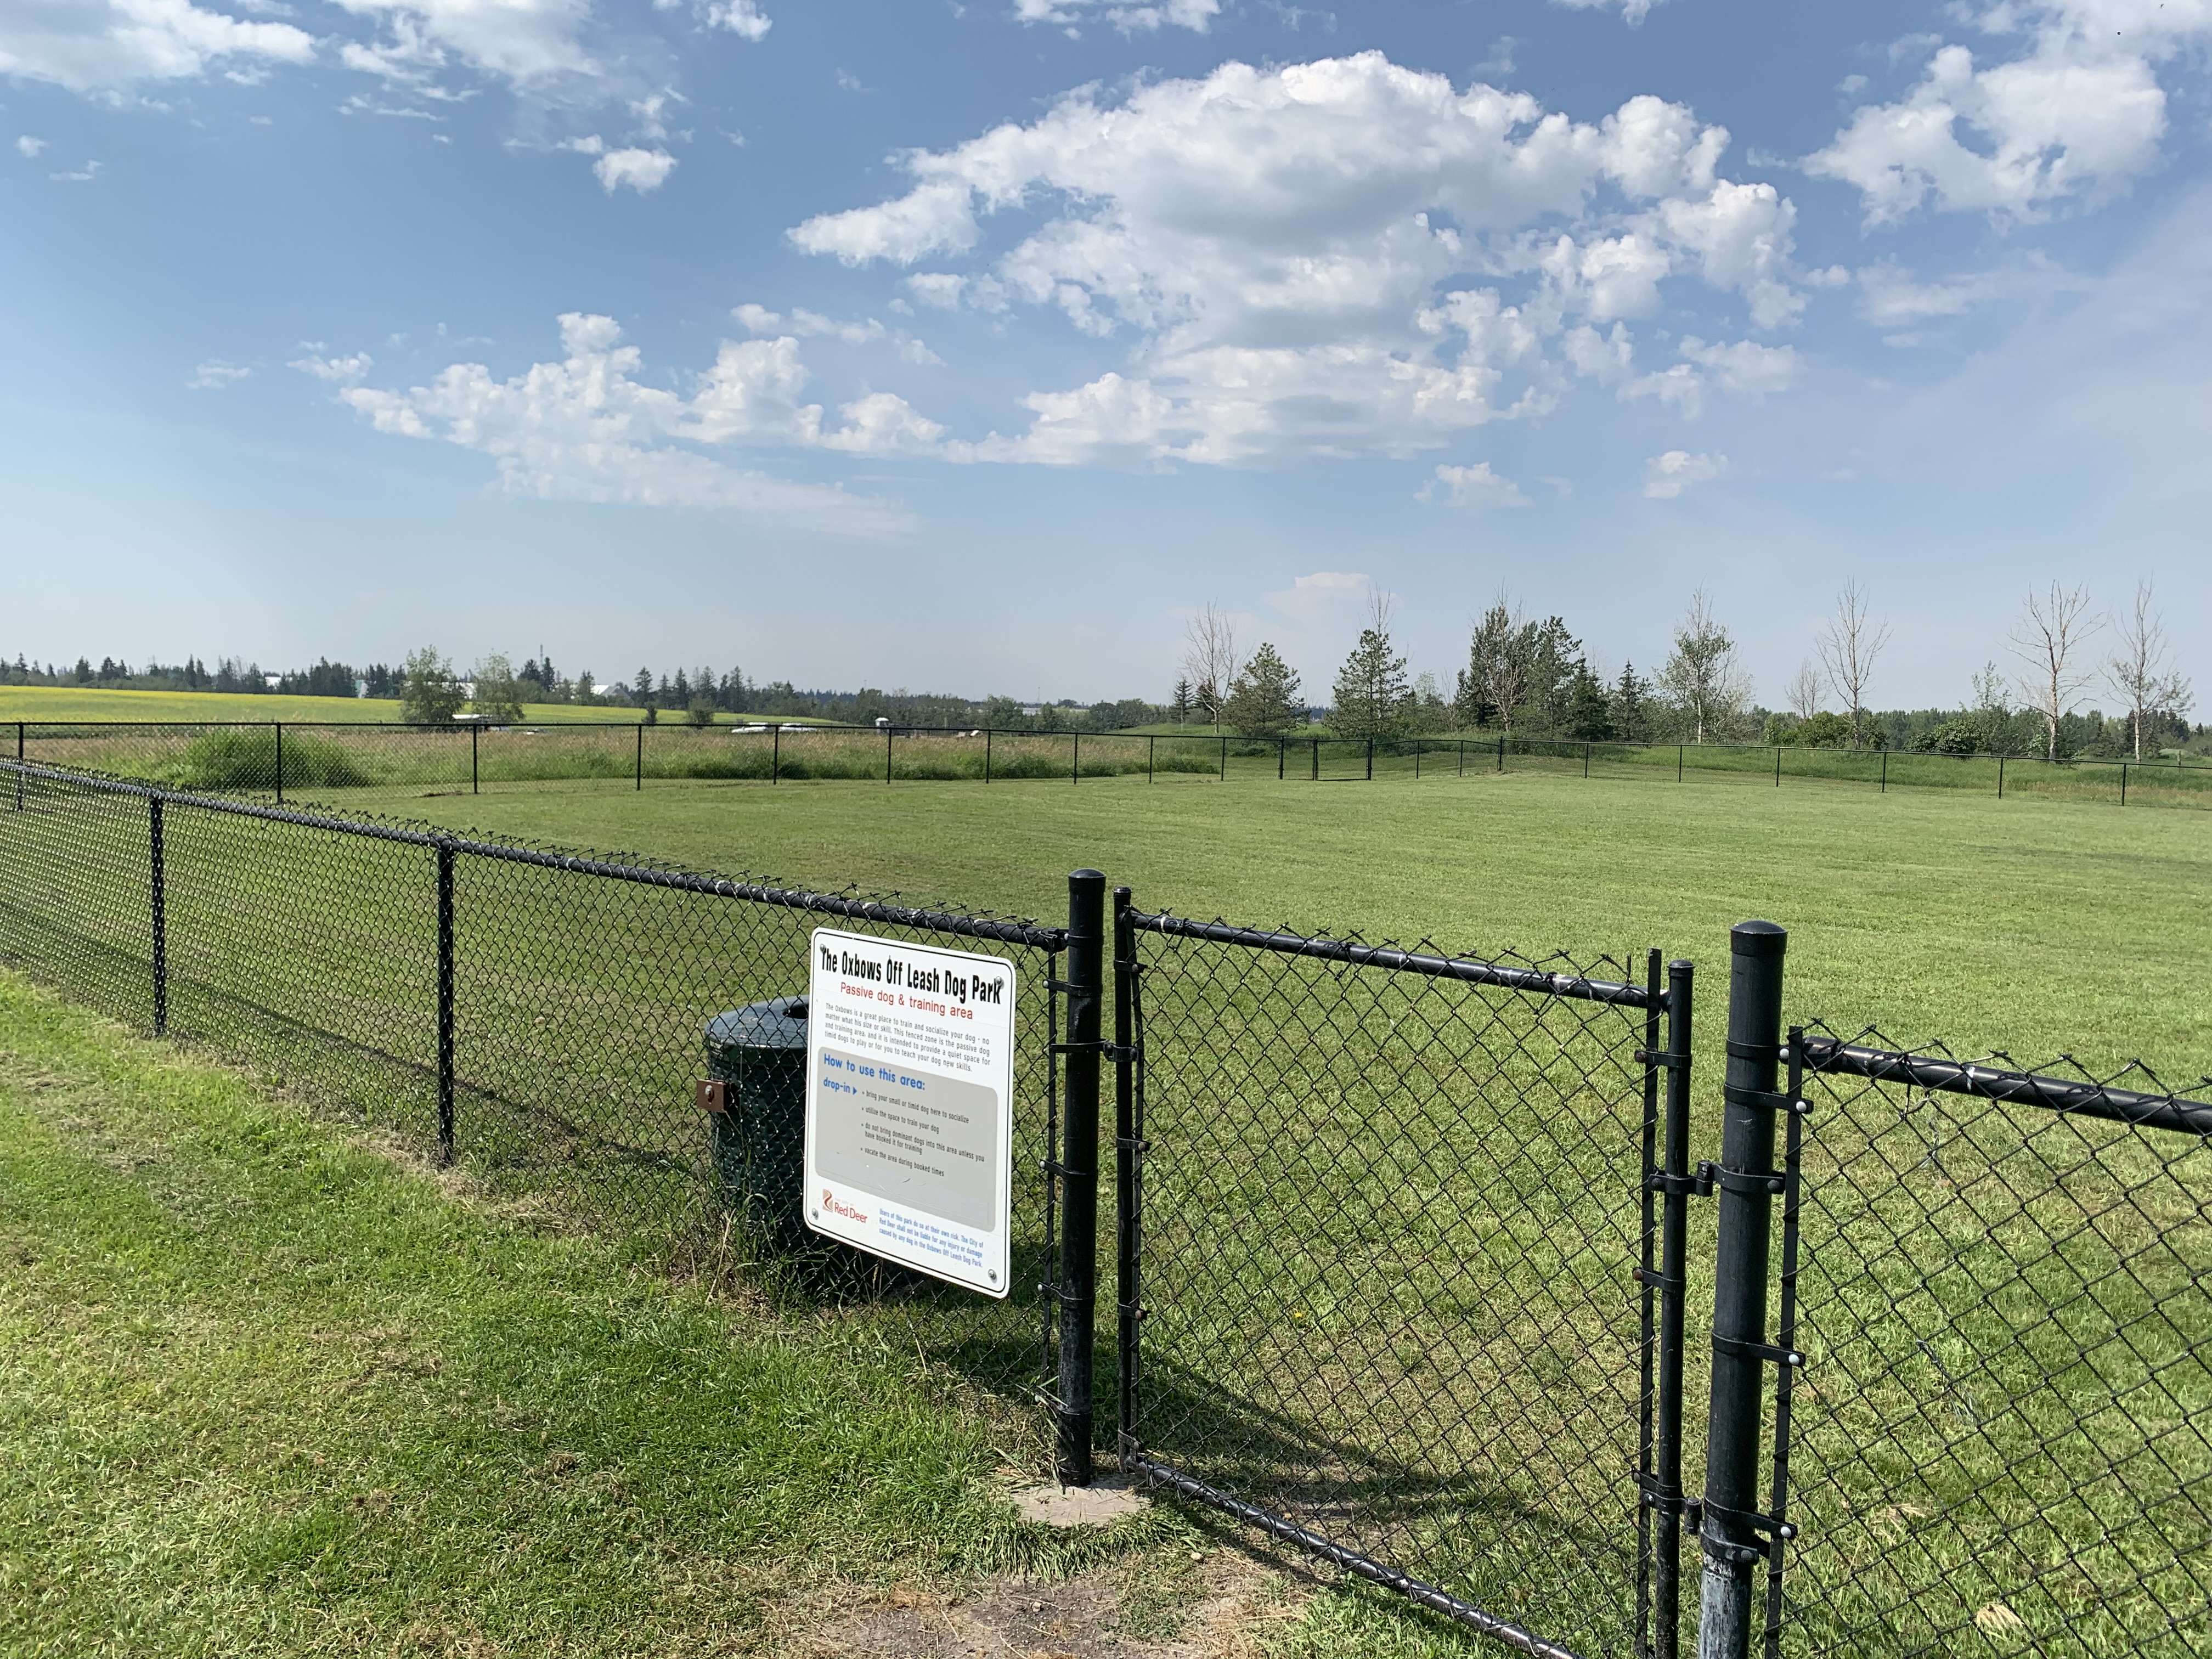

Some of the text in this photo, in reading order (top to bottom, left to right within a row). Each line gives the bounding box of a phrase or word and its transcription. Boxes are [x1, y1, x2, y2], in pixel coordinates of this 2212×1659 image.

[842, 951, 881, 981] Oxbows
[886, 958, 902, 985] Off
[907, 963, 939, 992] Leash
[944, 970, 967, 1003] Dog
[972, 975, 1002, 1005] Park
[841, 982, 973, 1019] Passive dog & training area
[825, 1013, 840, 1021] matter
[842, 1015, 853, 1024] what
[862, 1020, 872, 1029] size
[894, 1027, 904, 1036] This
[905, 1029, 923, 1040] fenced
[924, 1035, 938, 1044] zone
[939, 1037, 944, 1045] is
[945, 1039, 955, 1047] the
[956, 1042, 977, 1052] passive
[979, 1046, 990, 1057] dog
[826, 1002, 834, 1011] The
[834, 1004, 853, 1015] Oxbows
[864, 1012, 877, 1020] great
[878, 1014, 892, 1024] place
[900, 1019, 912, 1028] train
[914, 1023, 924, 1031] and
[926, 1026, 949, 1036] socialize
[950, 1031, 963, 1039] your
[964, 1032, 975, 1044] dog
[825, 1030, 837, 1039] timid
[837, 1032, 849, 1043] dogs
[856, 1038, 867, 1048] play
[884, 1046, 893, 1054] you
[901, 1049, 916, 1059] teach
[917, 1053, 929, 1062] your
[931, 1055, 941, 1066] dog
[943, 1059, 955, 1068] new
[834, 1023, 853, 1036] training
[883, 1034, 888, 1042] is
[889, 1036, 912, 1048] intended
[921, 1045, 941, 1054] provide
[947, 1051, 962, 1059] quiet
[963, 1054, 980, 1063] space
[981, 1056, 991, 1066] for
[823, 1077, 850, 1093] drop-in
[824, 1053, 926, 1090] How to use this area:
[865, 1107, 878, 1115] utilize
[888, 1113, 900, 1122] space
[907, 1118, 918, 1127] train
[919, 1122, 929, 1130] your
[930, 1123, 939, 1135] dog
[866, 1090, 877, 1101] bring
[889, 1097, 901, 1105] small
[907, 1101, 919, 1110] timid
[920, 1104, 929, 1115] dog
[930, 1107, 941, 1116] here
[949, 1113, 969, 1124] socialize
[865, 1121, 871, 1130] do
[879, 1125, 891, 1137] bring
[892, 1129, 913, 1142] dominant
[913, 1135, 925, 1147] dogs
[926, 1139, 935, 1148] into
[936, 1142, 945, 1151] this
[946, 1146, 957, 1154] area
[958, 1149, 974, 1159] unless
[975, 1154, 985, 1163] you
[865, 1130, 875, 1139] have
[876, 1133, 891, 1144] booked
[905, 1142, 922, 1155] training
[865, 1147, 878, 1156] vacate
[888, 1154, 898, 1163] area
[898, 1156, 913, 1169] during
[913, 1160, 930, 1173] booked
[932, 1167, 944, 1177] times
[834, 1202, 867, 1223] Red Deer
